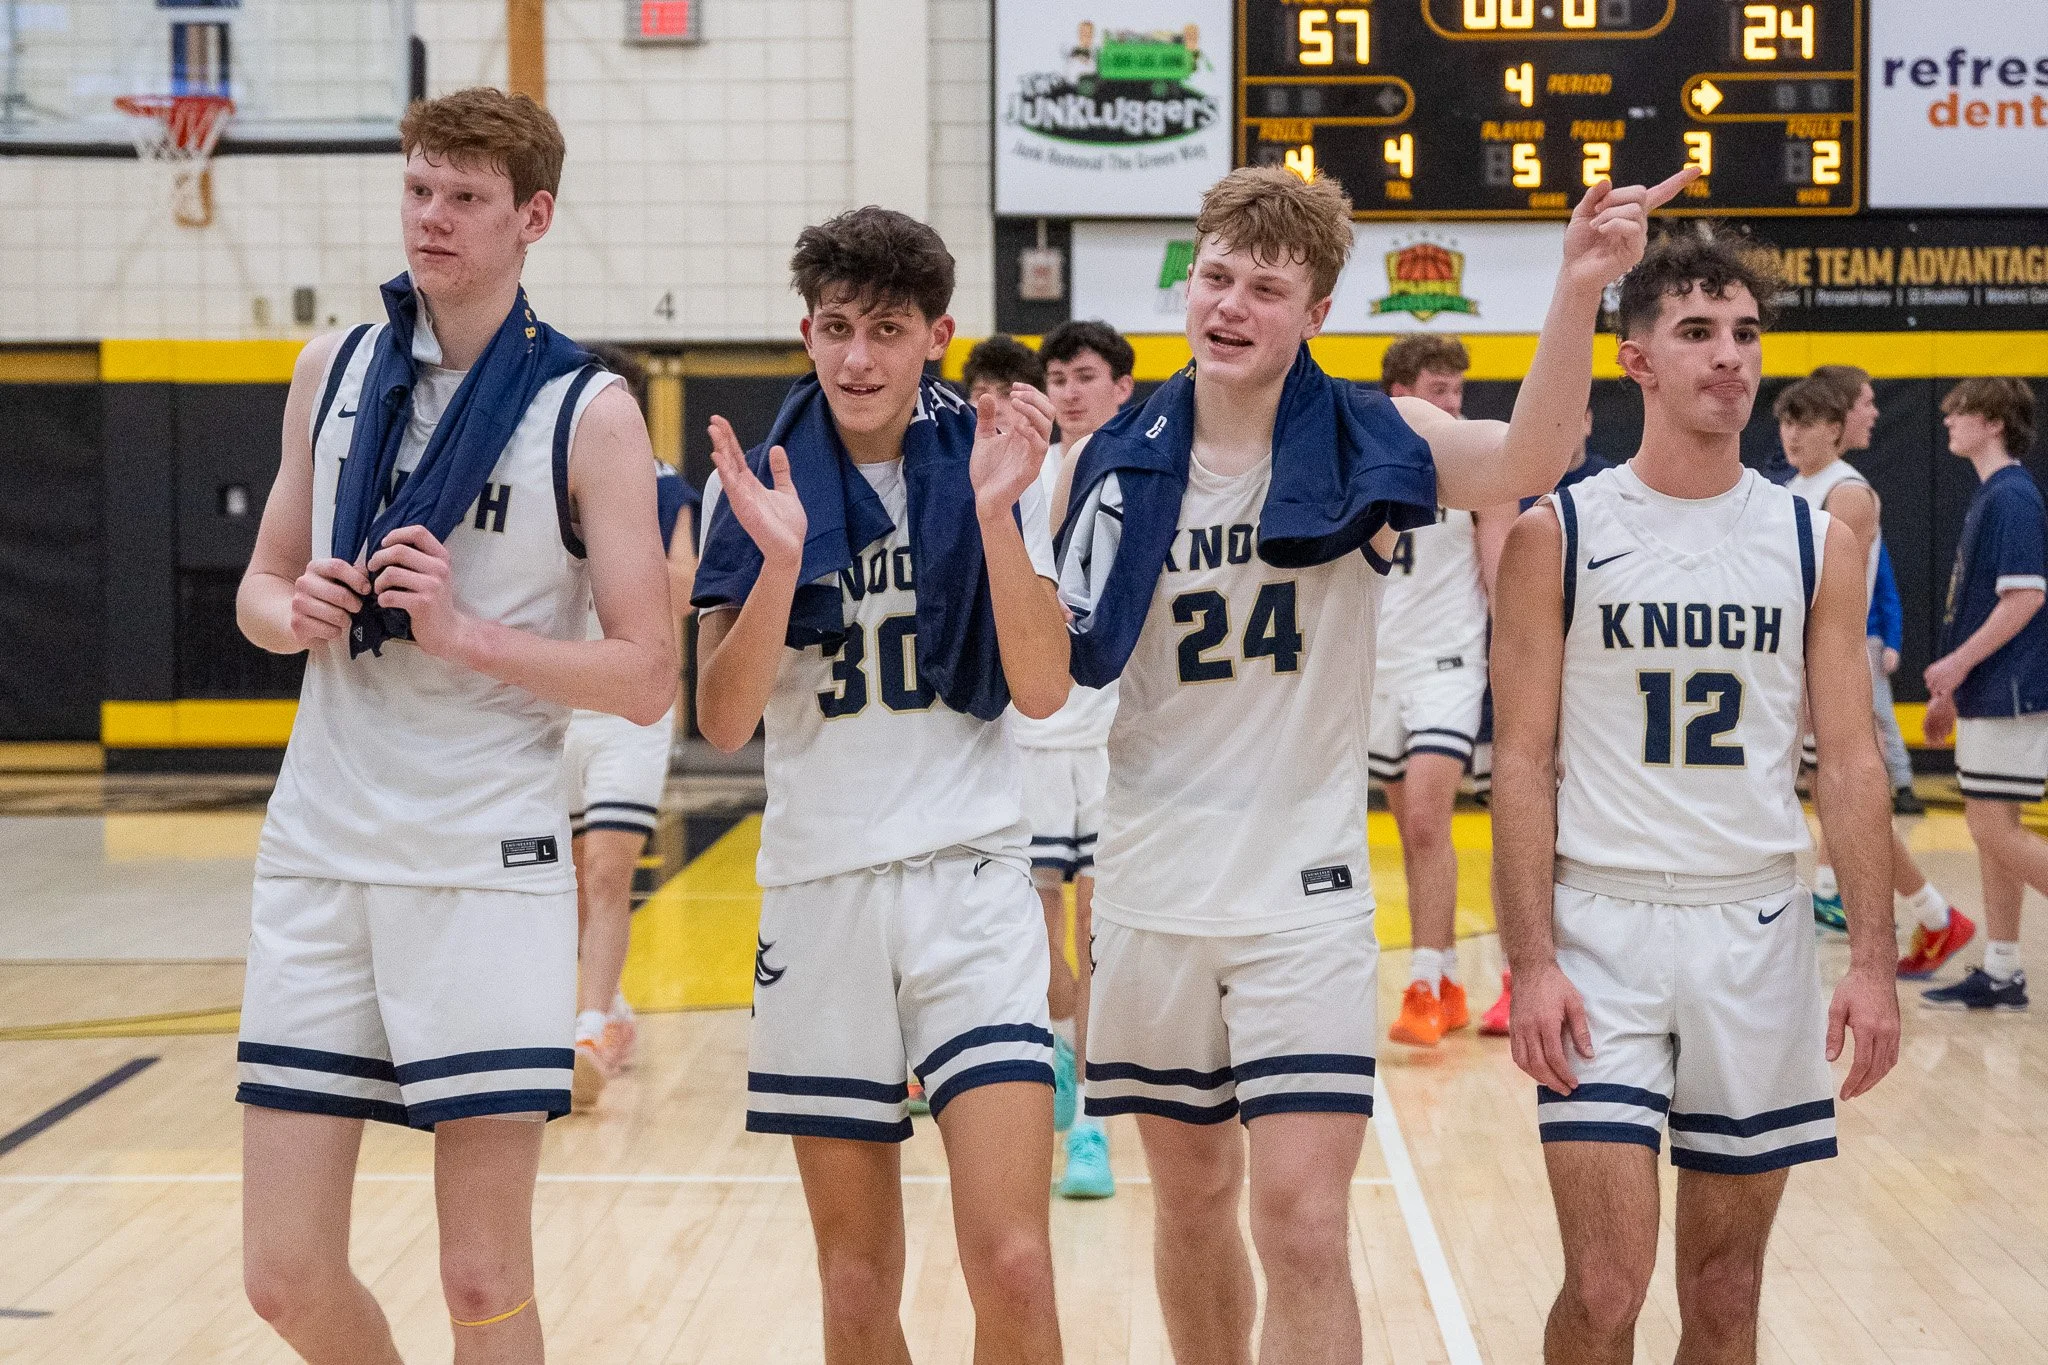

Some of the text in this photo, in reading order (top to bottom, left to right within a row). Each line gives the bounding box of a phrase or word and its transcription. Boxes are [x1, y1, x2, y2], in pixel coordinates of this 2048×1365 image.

[1299, 9, 1370, 65] 57
[1743, 4, 1815, 60] 24
[1504, 62, 1534, 108] 4
[1546, 73, 1613, 95] PERIOD
[1481, 119, 1626, 141] PLAYER FOULS
[1285, 144, 1315, 185] 4
[1384, 133, 1414, 179] 4
[1512, 142, 1541, 188] 5
[1582, 142, 1612, 187] 2
[1683, 131, 1712, 176] 3
[1812, 140, 1841, 185] 2
[1814, 247, 1894, 285] TEAM
[656, 293, 676, 321] 4
[1172, 579, 1305, 686] 24
[1598, 601, 1782, 654] KNOCH
[816, 612, 942, 722] 30
[1635, 668, 1747, 769] 12
[543, 845, 551, 856] L
[1337, 873, 1345, 883] L
